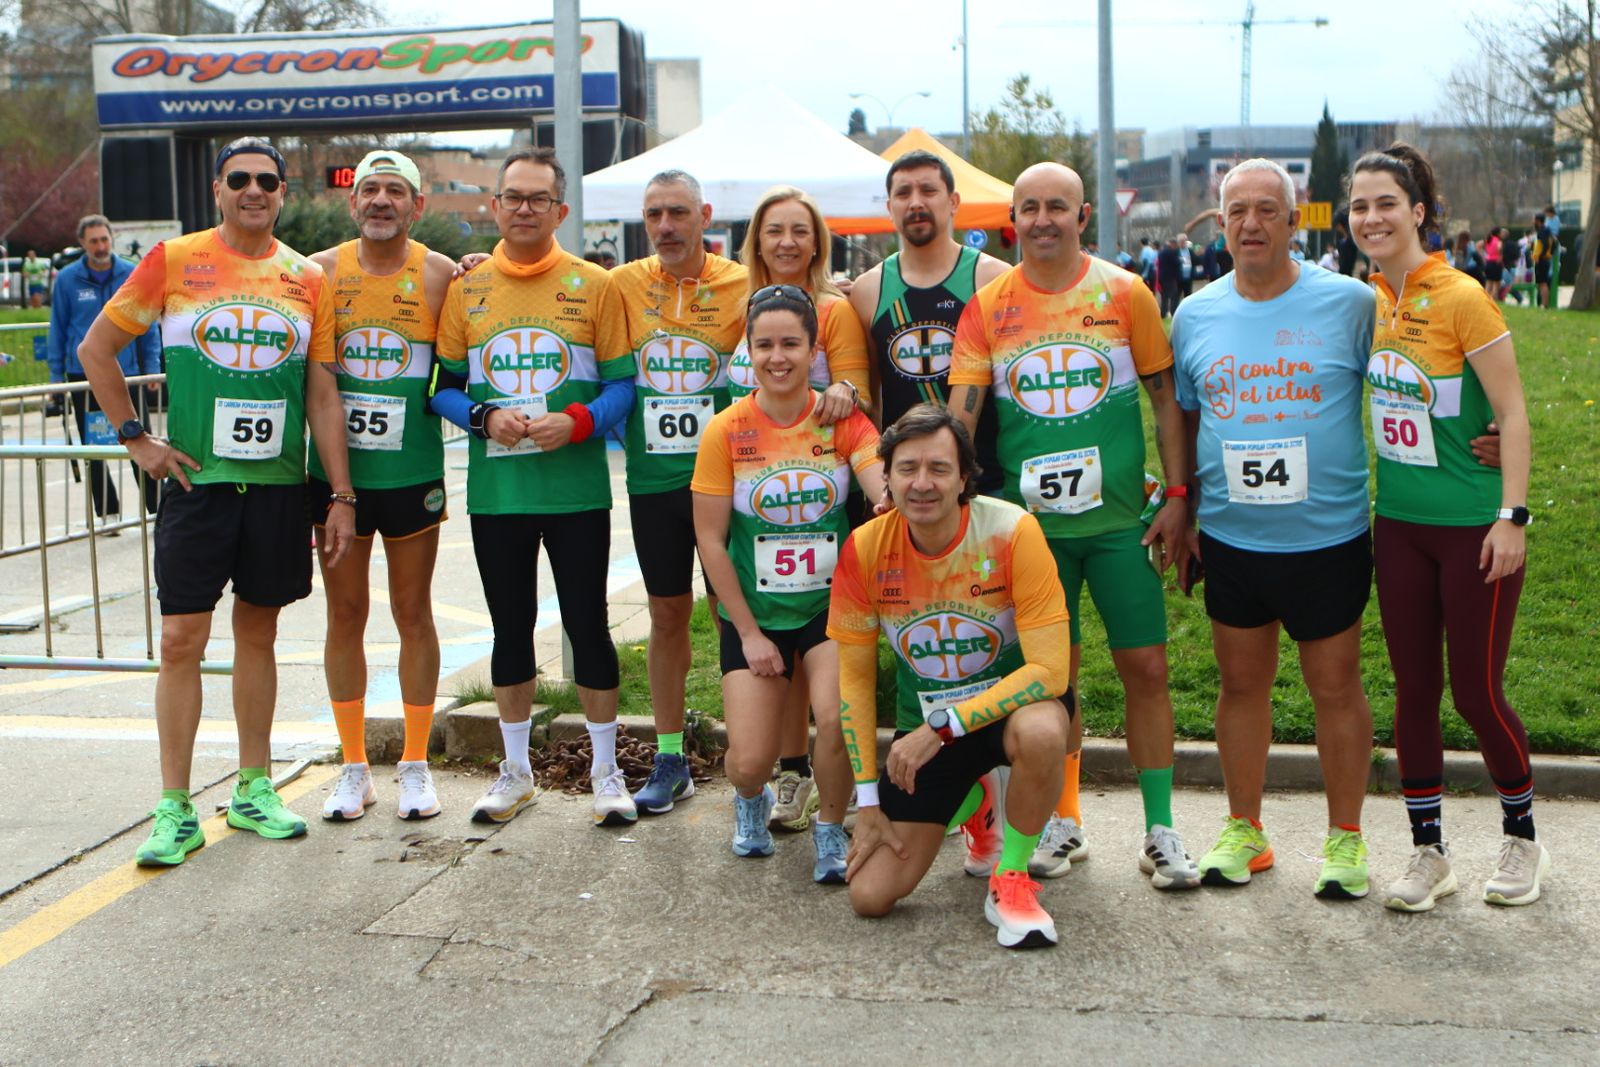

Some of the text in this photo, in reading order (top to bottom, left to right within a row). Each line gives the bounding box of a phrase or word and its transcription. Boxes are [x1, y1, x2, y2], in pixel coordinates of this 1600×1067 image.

[160, 83, 544, 114] www.orycronsport.com
[195, 297, 225, 315] CLUB
[231, 294, 299, 323] DEPORTIVO
[204, 326, 289, 352] ALCER
[896, 342, 954, 359] ALCER
[1003, 332, 1111, 364] CLUB DEPORTIVO
[342, 346, 404, 365] ALCER
[490, 352, 563, 373] ALCER
[646, 356, 712, 375] ALCER
[1239, 357, 1314, 380] contra
[1017, 366, 1103, 392] ALCER
[1240, 380, 1325, 404] el ictus
[1369, 371, 1426, 403] ALCER
[232, 417, 274, 443] 59
[347, 409, 389, 435] 55
[659, 413, 699, 438] 60
[1383, 417, 1419, 447] 50
[751, 459, 834, 485] CLUB DEPORTIVO
[1039, 468, 1084, 500] 57
[1242, 458, 1290, 488] 54
[760, 487, 829, 509] ALCER
[774, 548, 816, 576] 51
[893, 600, 996, 629] CLUB DEPORTIVO
[908, 635, 993, 660] ALCER
[969, 681, 1054, 727] ALCER
[840, 699, 863, 774] ALCER
